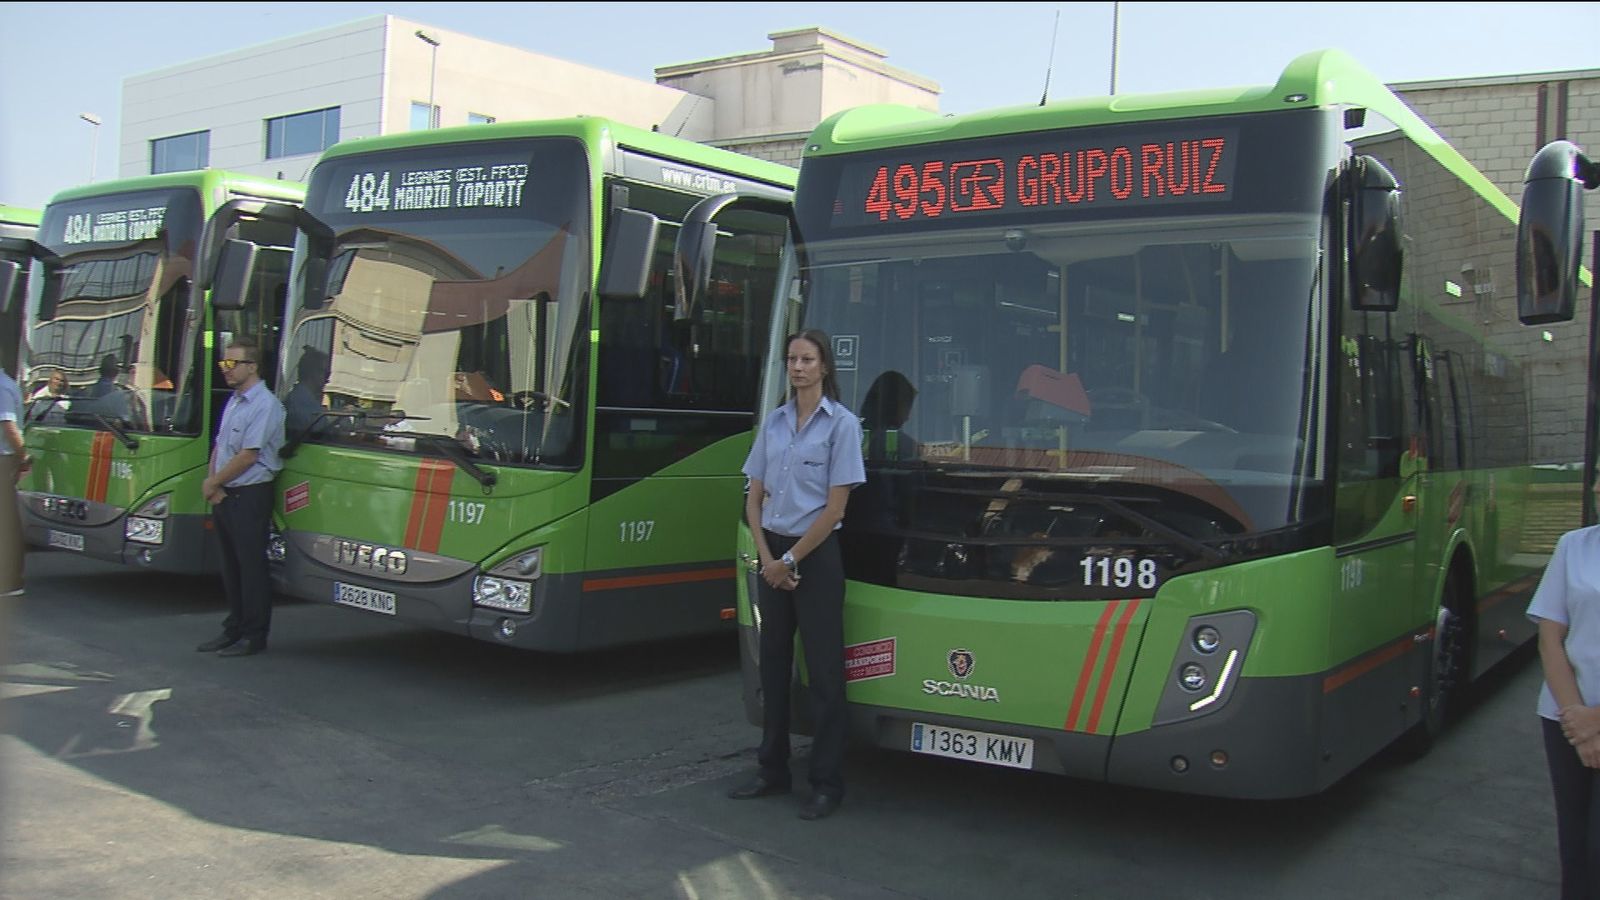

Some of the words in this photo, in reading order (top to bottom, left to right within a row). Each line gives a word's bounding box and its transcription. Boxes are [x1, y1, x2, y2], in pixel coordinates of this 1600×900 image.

[345, 171, 390, 212] 484
[864, 161, 946, 221] 495
[1017, 146, 1132, 206] GRUPO
[1141, 137, 1225, 199] RUIZ
[394, 184, 450, 210] MADRID
[449, 500, 486, 524] 1197
[620, 520, 655, 542] 1197
[334, 540, 408, 574] IVECO
[1079, 556, 1157, 590] 1198
[922, 679, 1001, 703] SCANIA
[930, 729, 977, 757] 1363
[985, 736, 1027, 764] KMV
